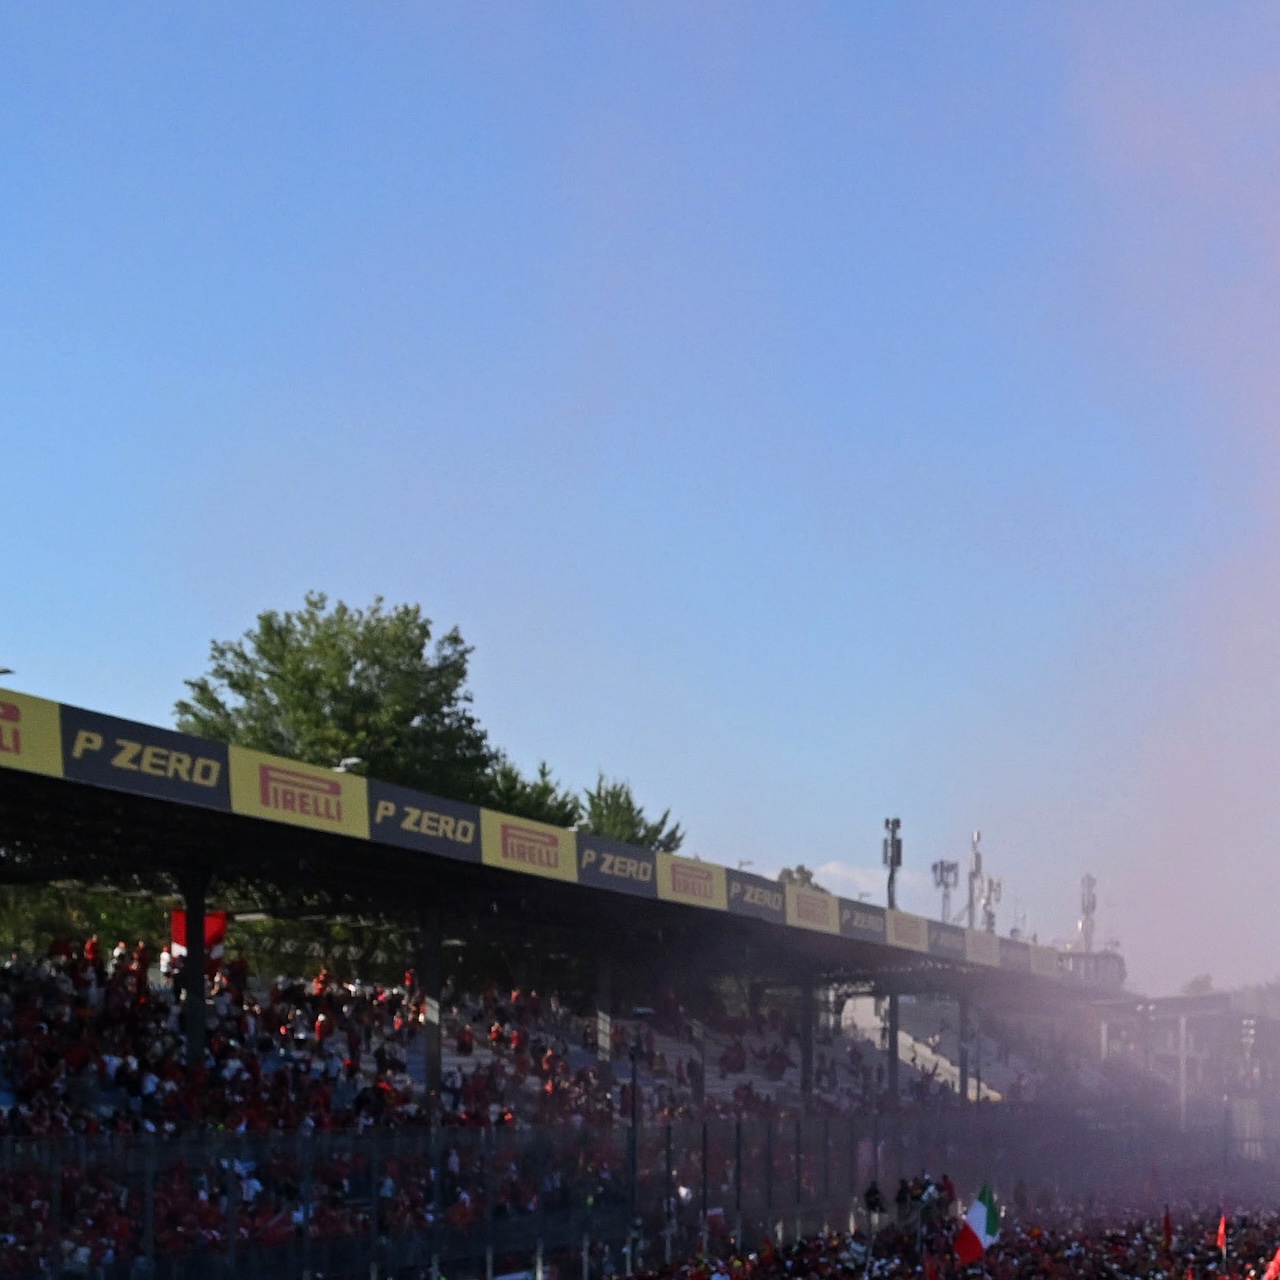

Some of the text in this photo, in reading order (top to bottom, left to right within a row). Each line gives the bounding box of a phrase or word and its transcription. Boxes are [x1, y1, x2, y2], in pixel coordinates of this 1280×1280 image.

[71, 729, 221, 788] P ZERO
[258, 762, 342, 823] PIRELLI
[375, 800, 476, 845] P ZERO
[600, 853, 653, 882] ZERO
